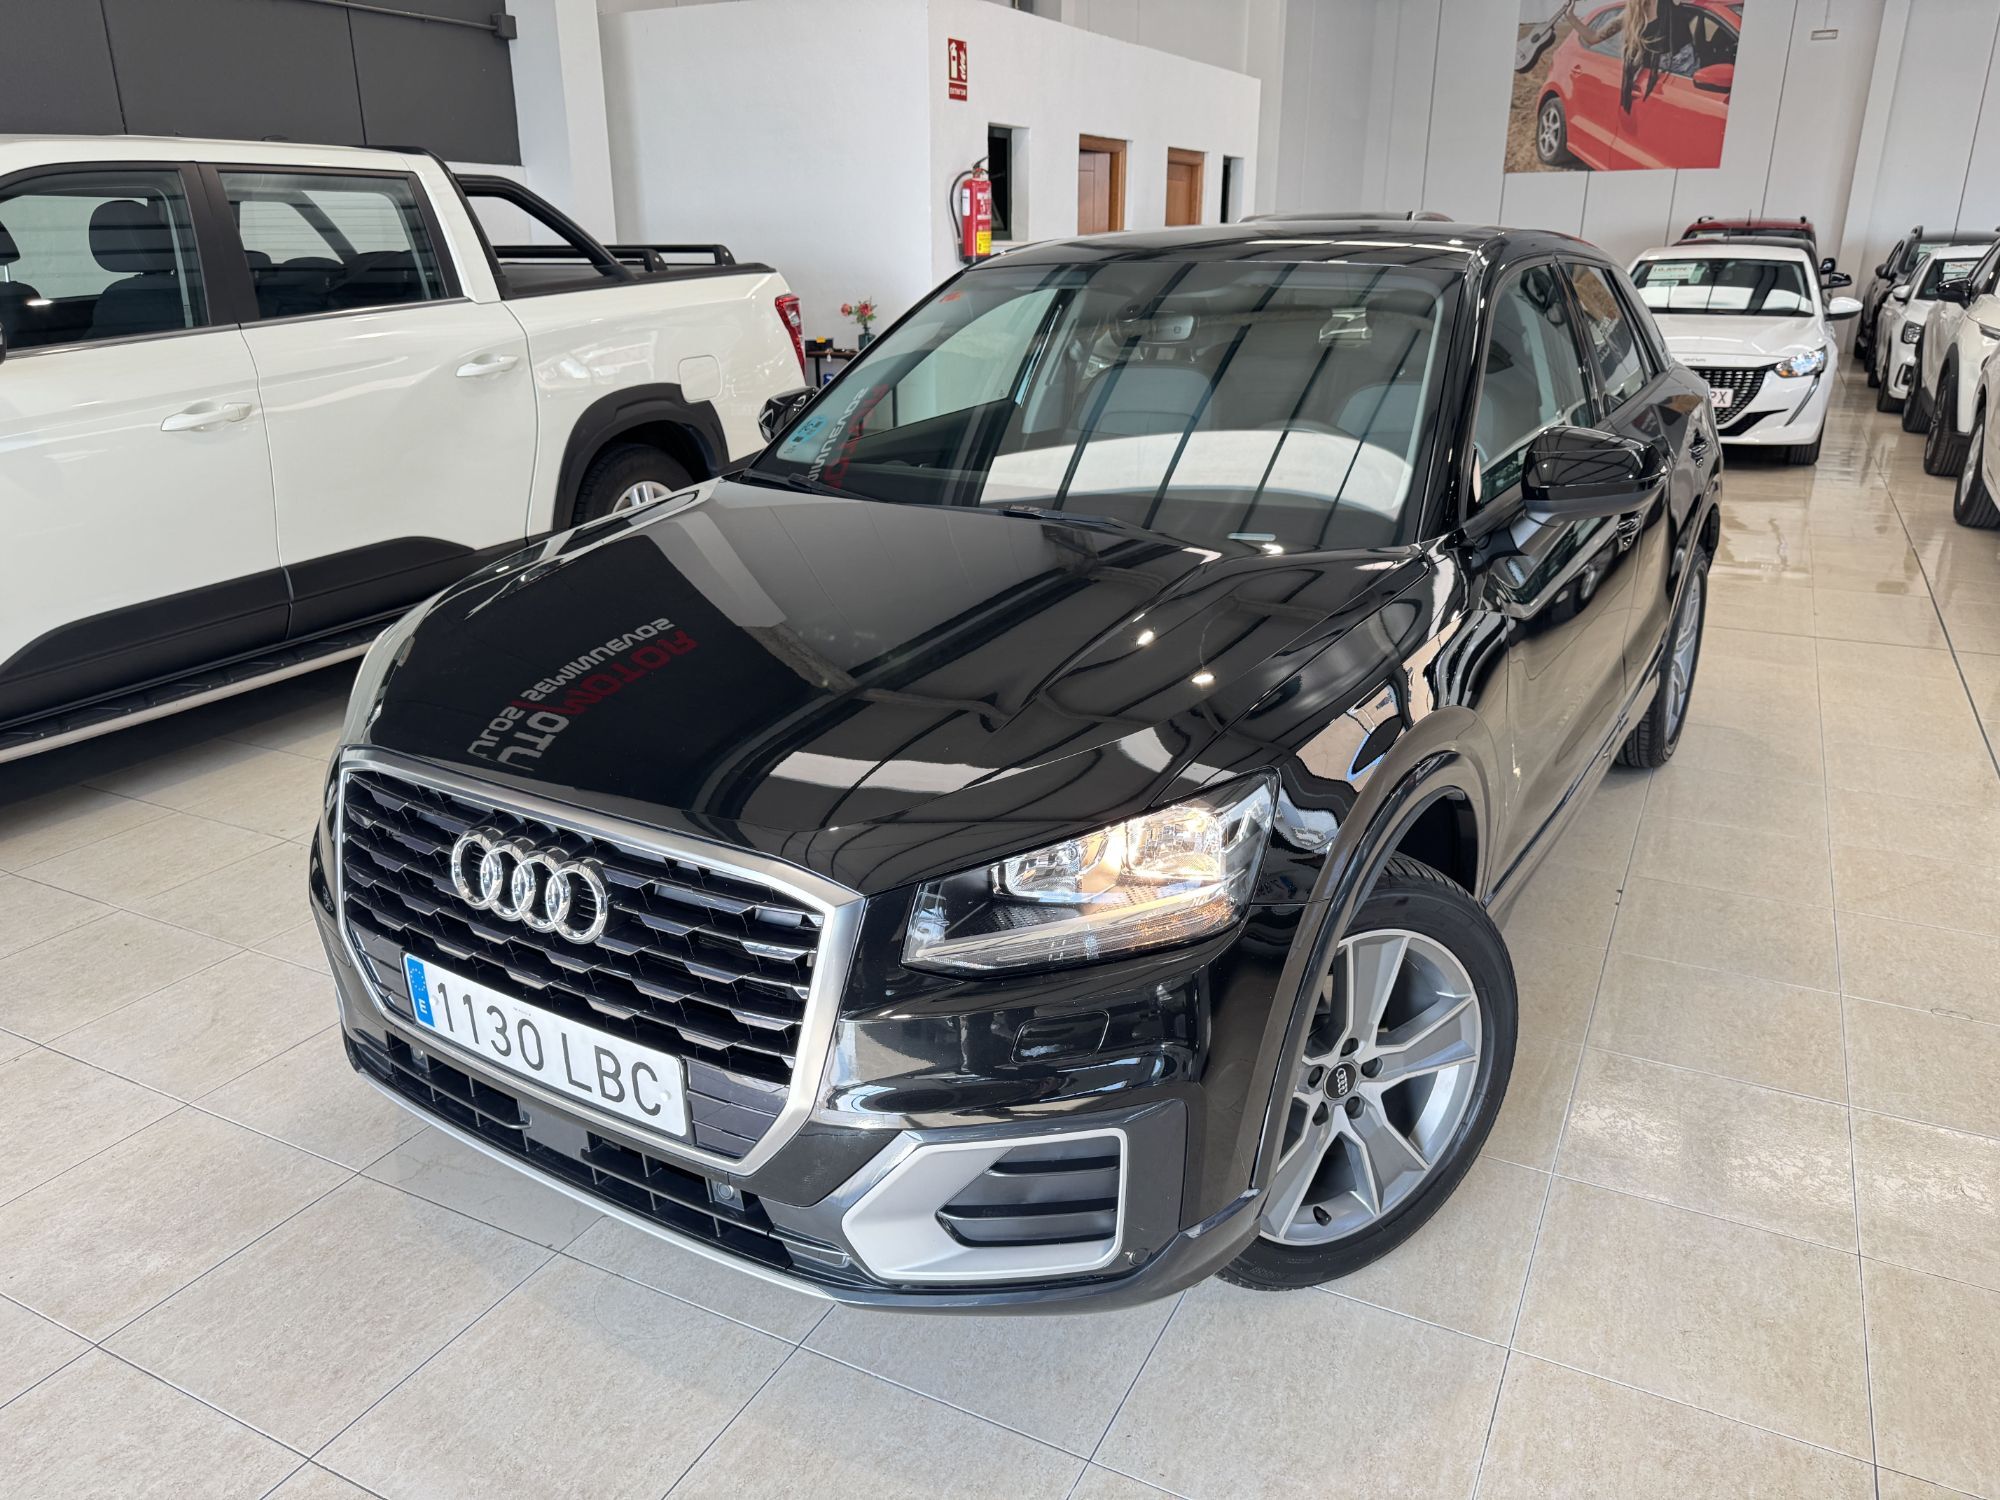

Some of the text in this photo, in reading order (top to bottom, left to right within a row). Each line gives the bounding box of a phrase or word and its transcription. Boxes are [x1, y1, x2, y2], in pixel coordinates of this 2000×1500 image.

[1710, 391, 1728, 404] PX
[418, 999, 428, 1014] E
[437, 982, 662, 1116] 1130 LBC
